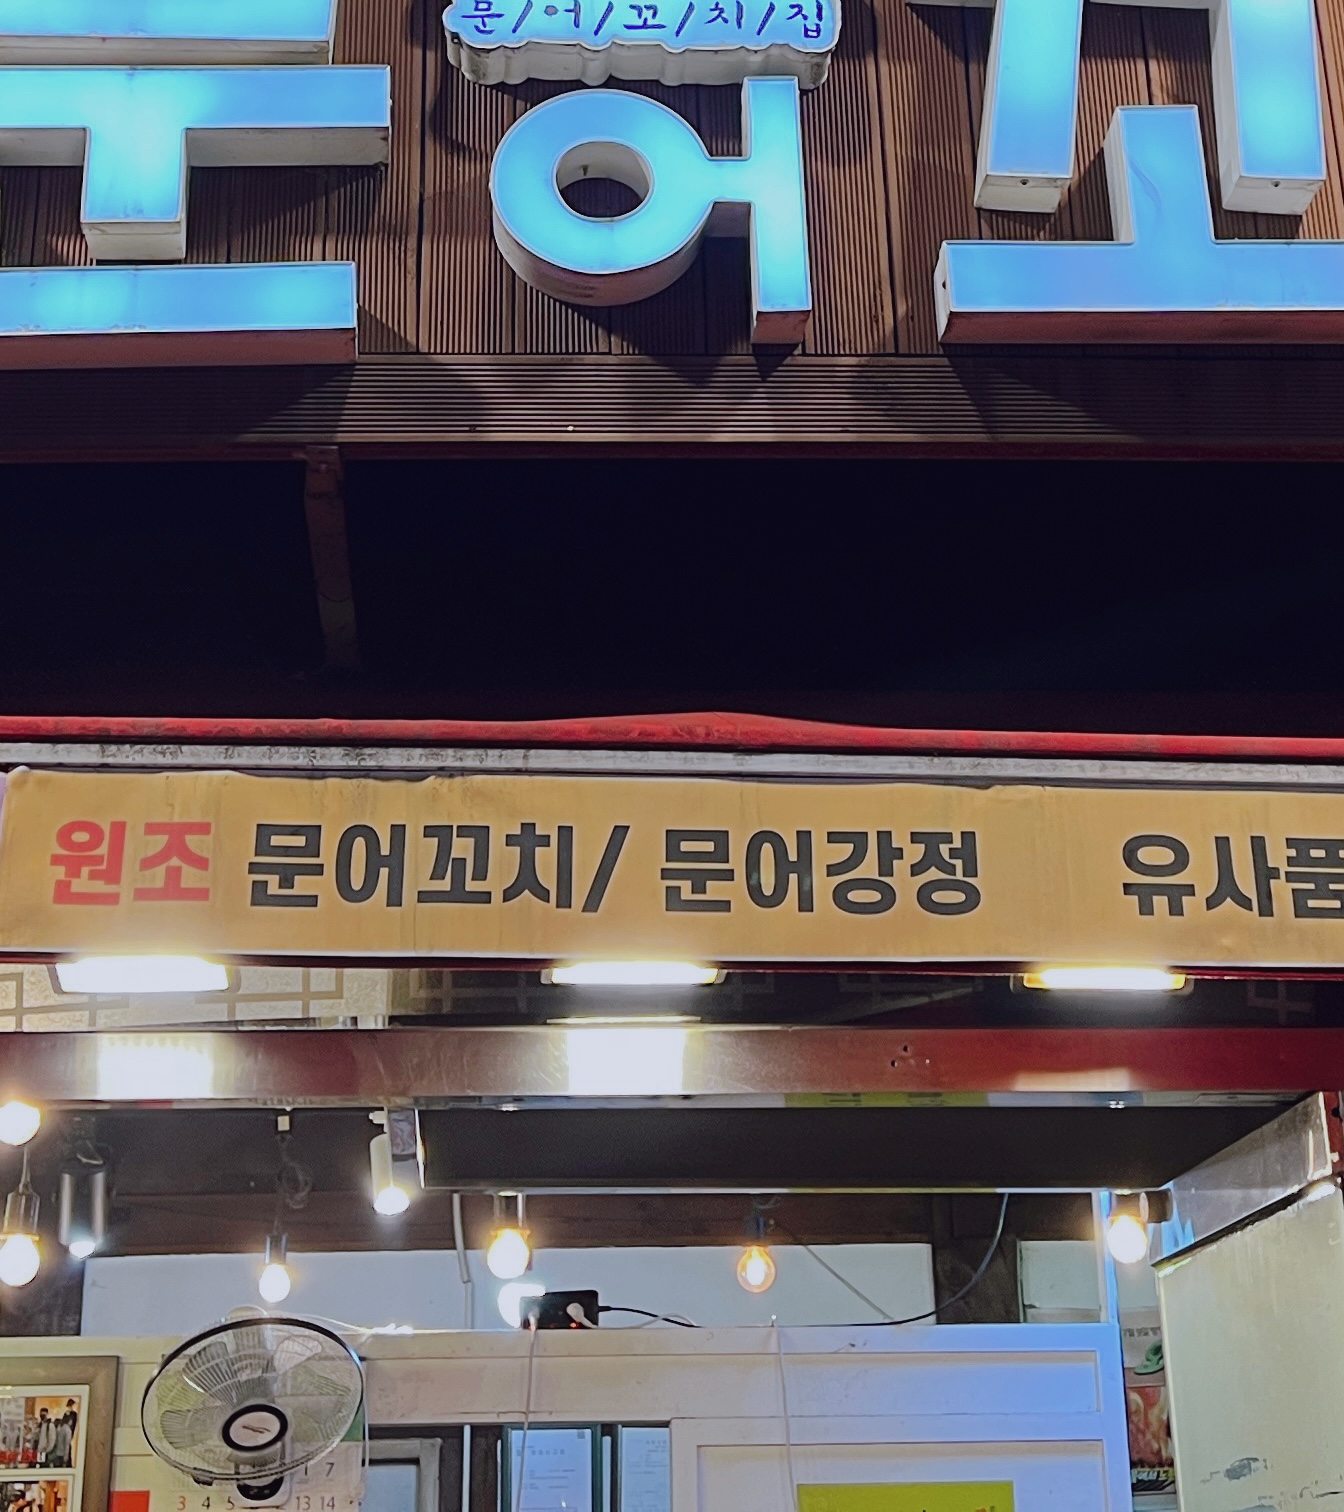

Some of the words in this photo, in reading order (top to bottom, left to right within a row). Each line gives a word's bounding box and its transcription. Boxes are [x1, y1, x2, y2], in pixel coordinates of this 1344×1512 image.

[50, 820, 212, 906] 원조
[248, 822, 630, 913] 문어꼬치/
[660, 829, 981, 916] 문어강정
